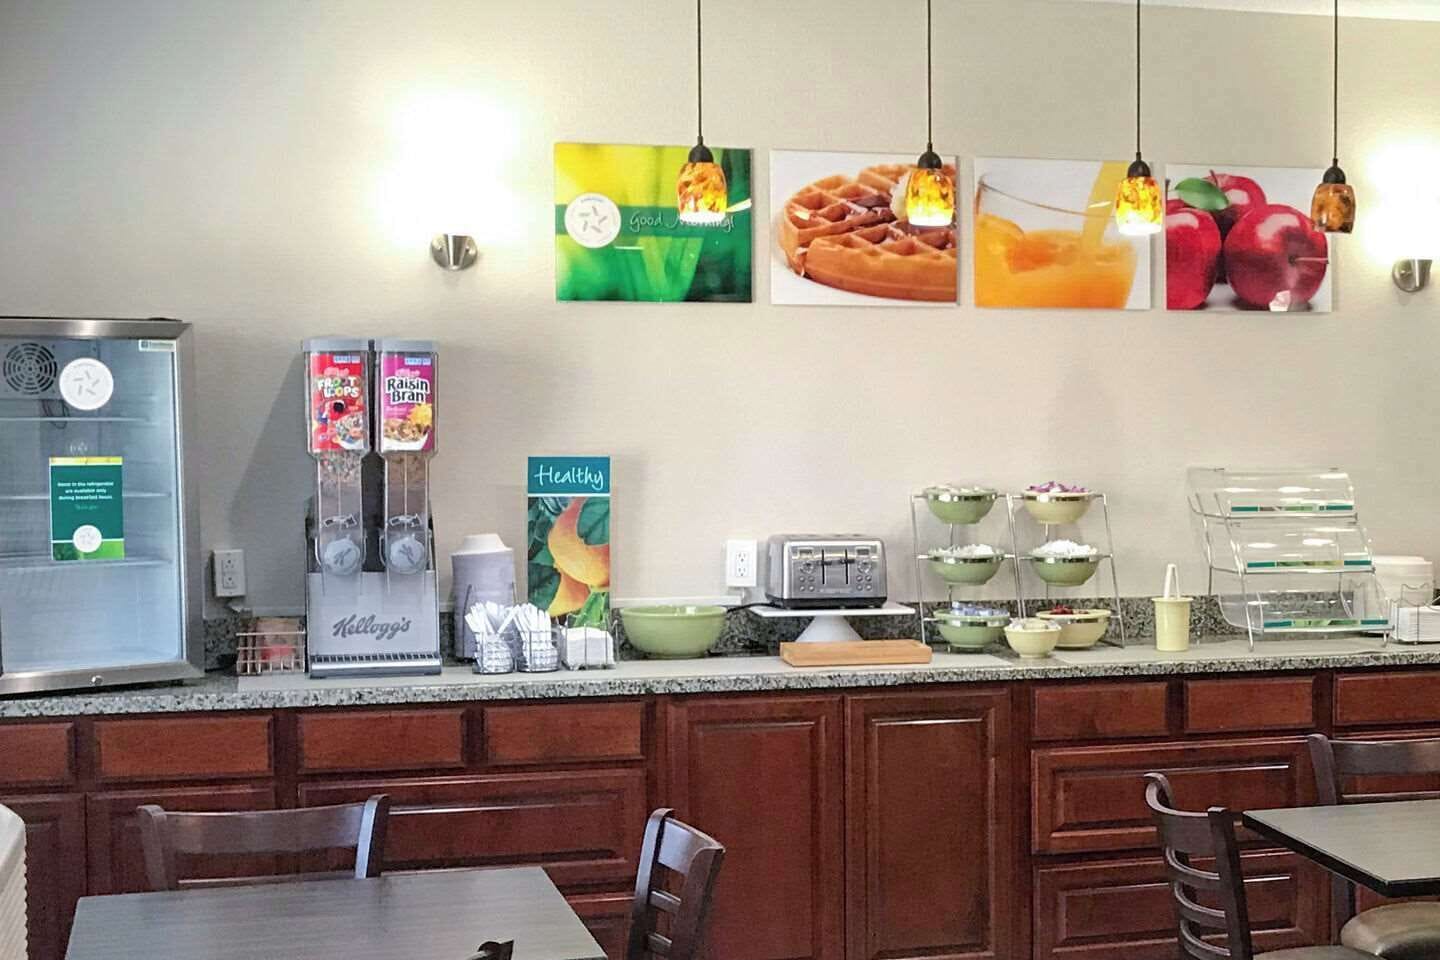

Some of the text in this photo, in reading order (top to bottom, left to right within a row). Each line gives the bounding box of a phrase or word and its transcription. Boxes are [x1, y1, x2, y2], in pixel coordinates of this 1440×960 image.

[629, 209, 665, 233] Good
[386, 376, 429, 394] Raisin
[391, 389, 425, 403] Bran
[533, 463, 604, 491] Healthy
[332, 613, 412, 641] Kellogg's
